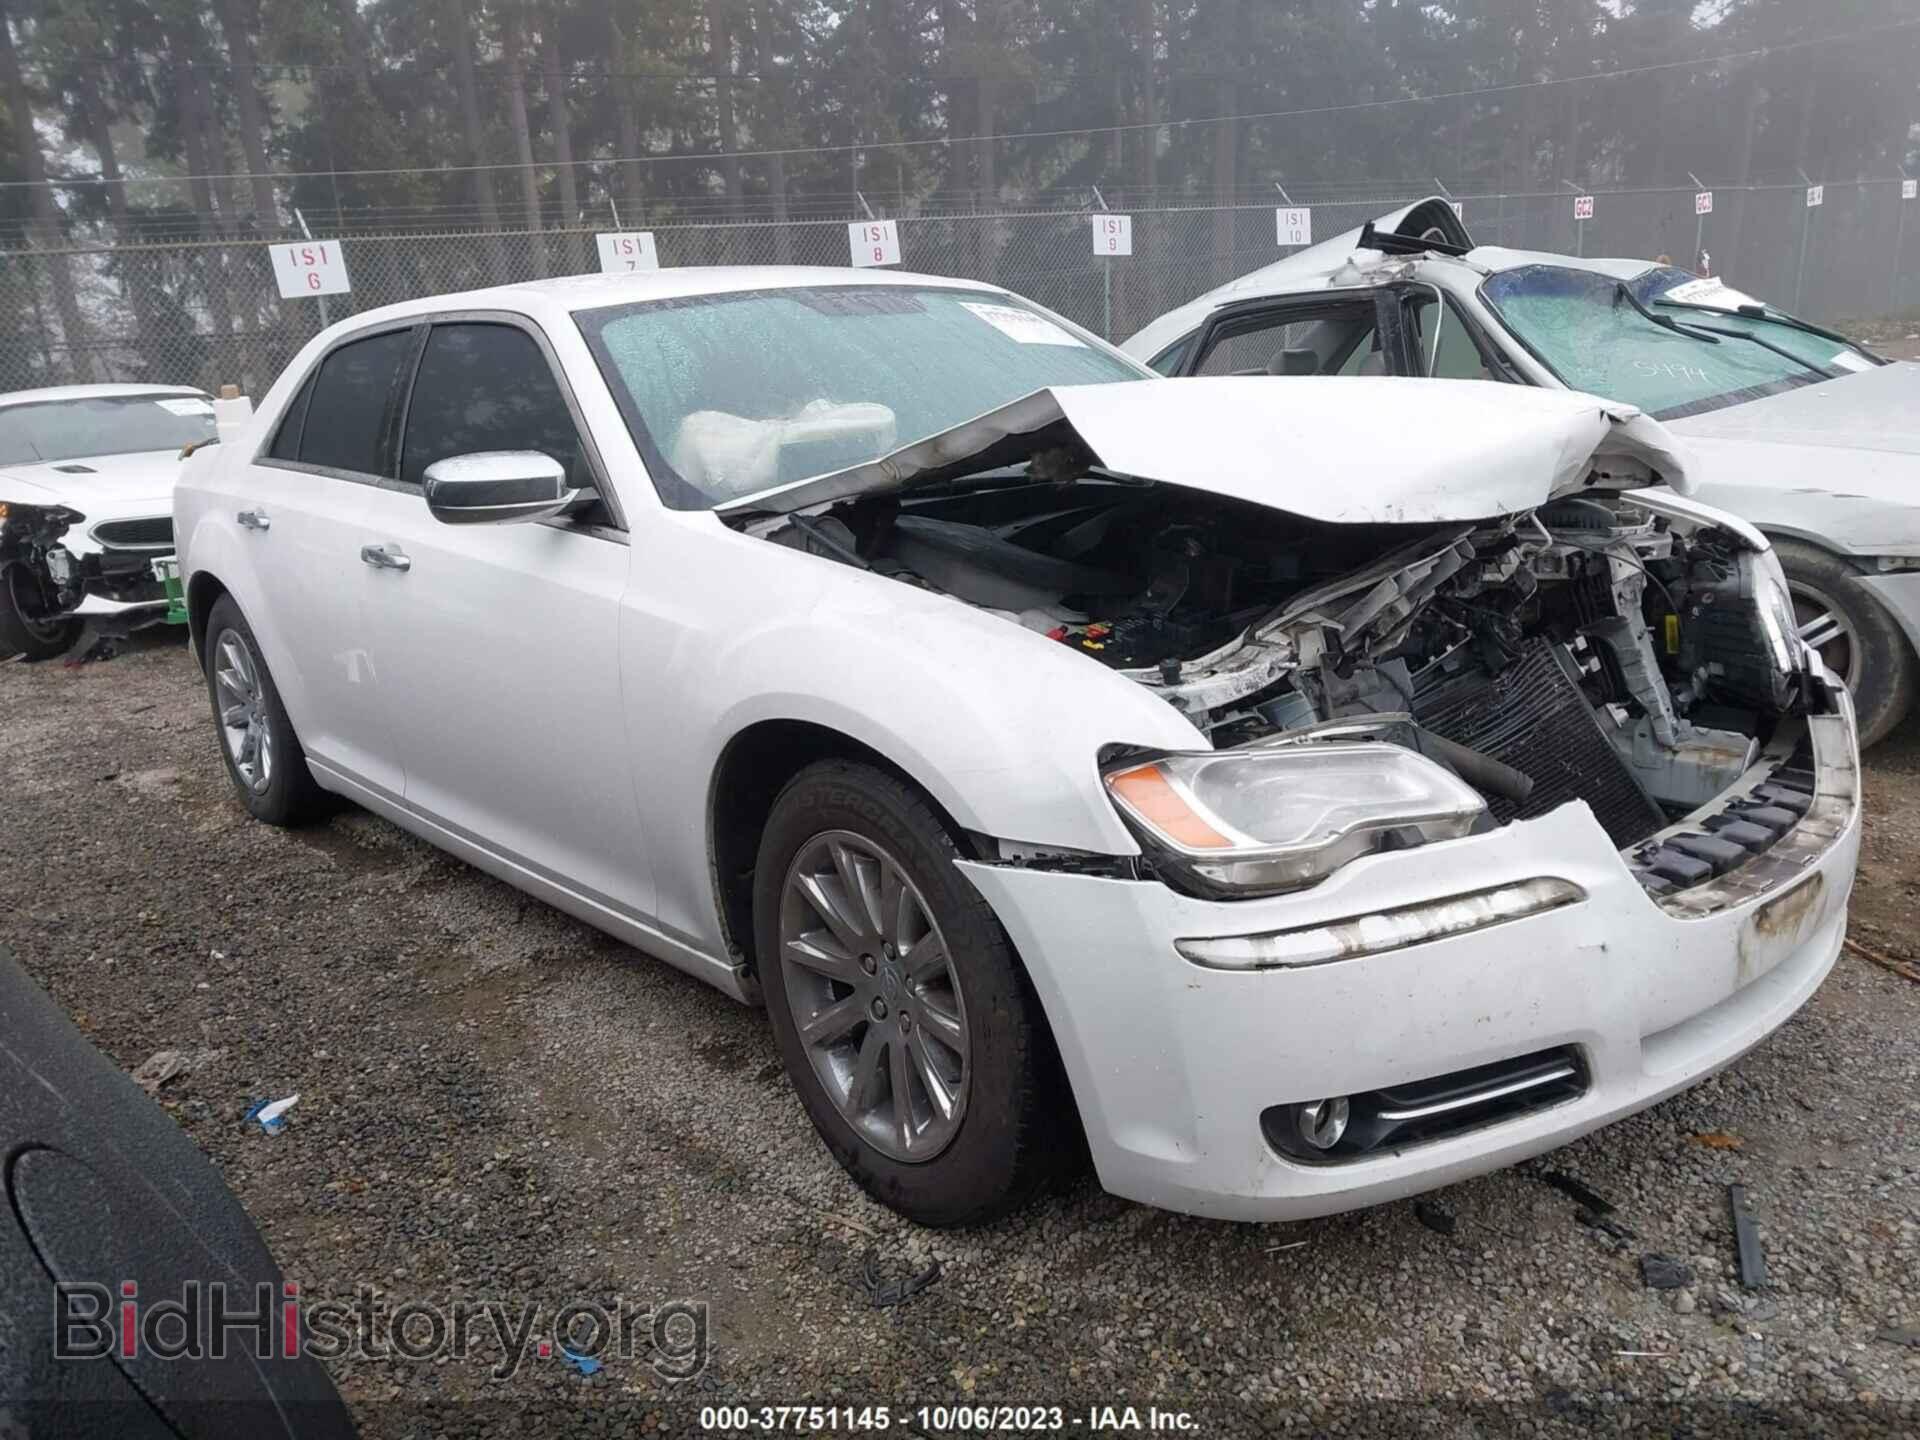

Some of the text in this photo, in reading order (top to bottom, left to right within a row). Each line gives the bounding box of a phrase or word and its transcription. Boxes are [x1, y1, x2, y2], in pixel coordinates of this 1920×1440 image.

[1290, 230, 1302, 242] 10
[873, 246, 883, 261] 8
[624, 260, 636, 271] 7
[307, 272, 322, 290] 6
